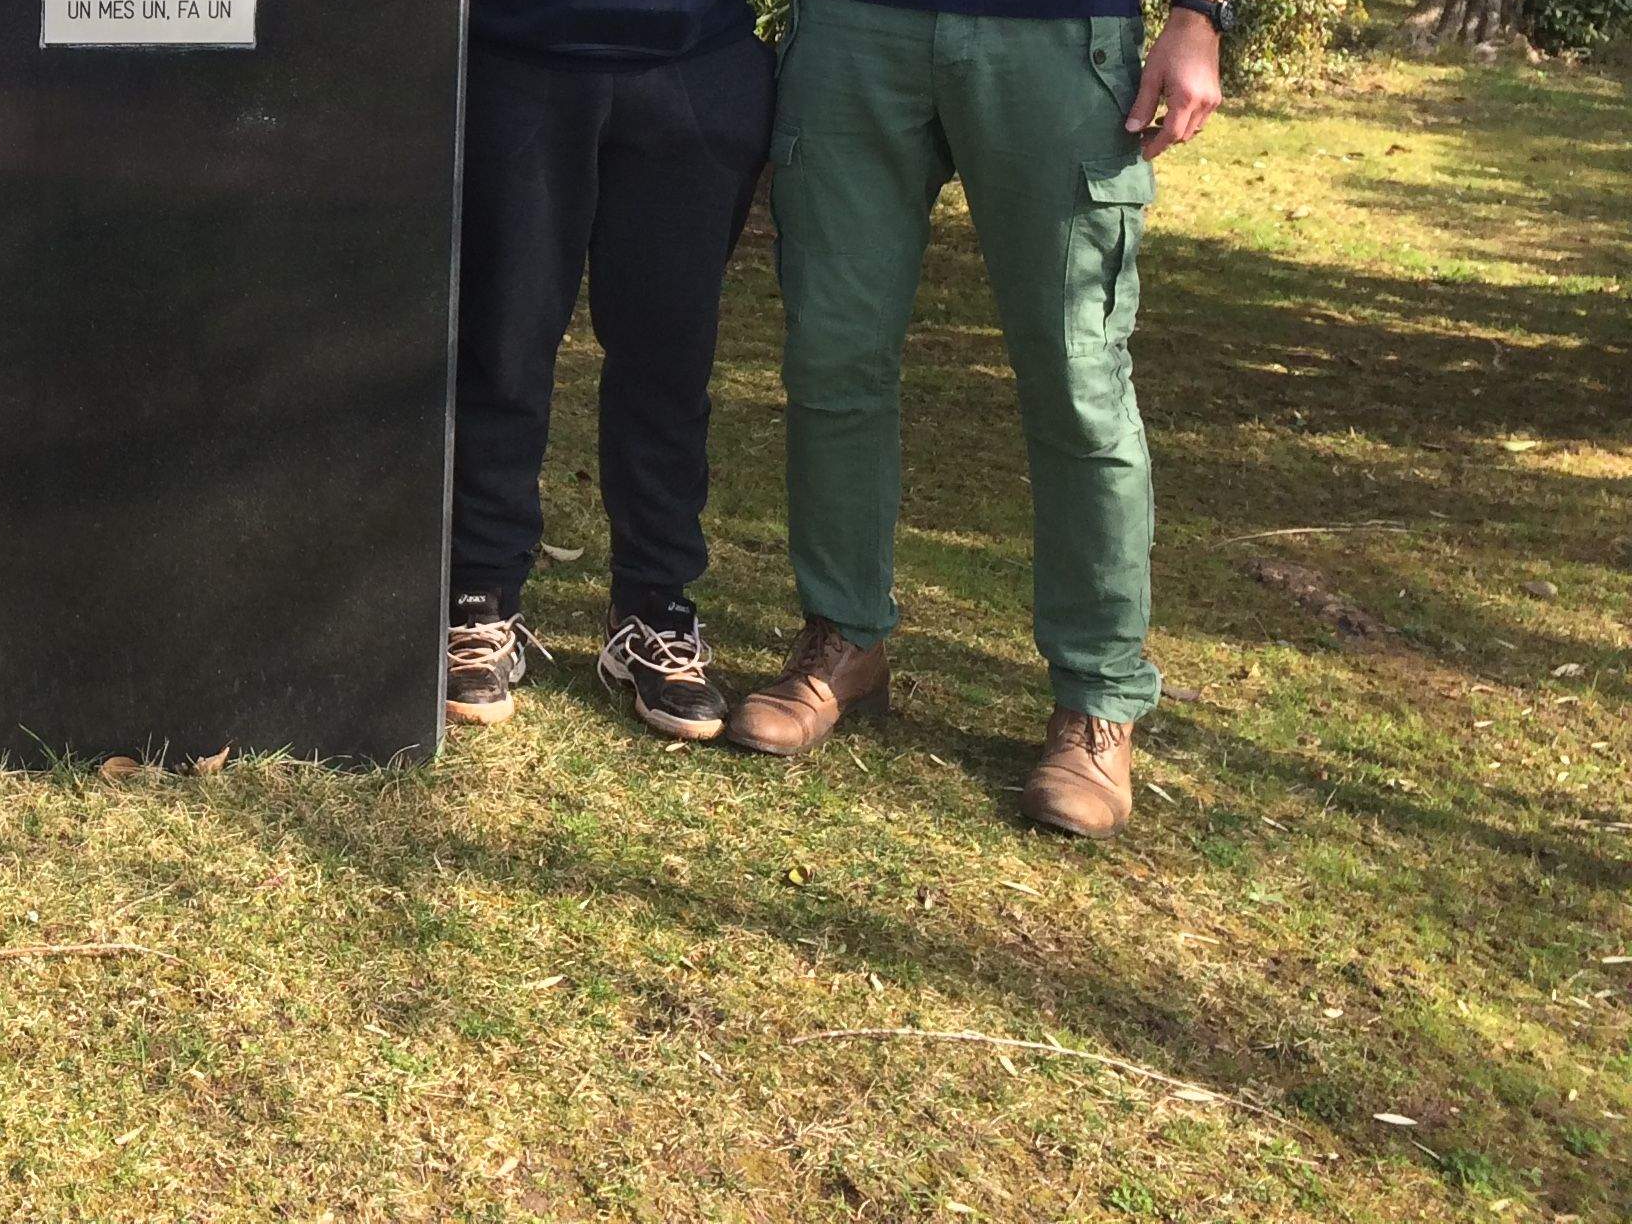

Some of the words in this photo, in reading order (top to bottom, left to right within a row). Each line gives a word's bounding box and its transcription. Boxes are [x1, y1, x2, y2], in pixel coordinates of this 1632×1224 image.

[67, 0, 91, 20] UN
[98, 0, 135, 20] MES
[178, 0, 200, 20] FA
[208, 0, 232, 20] UN
